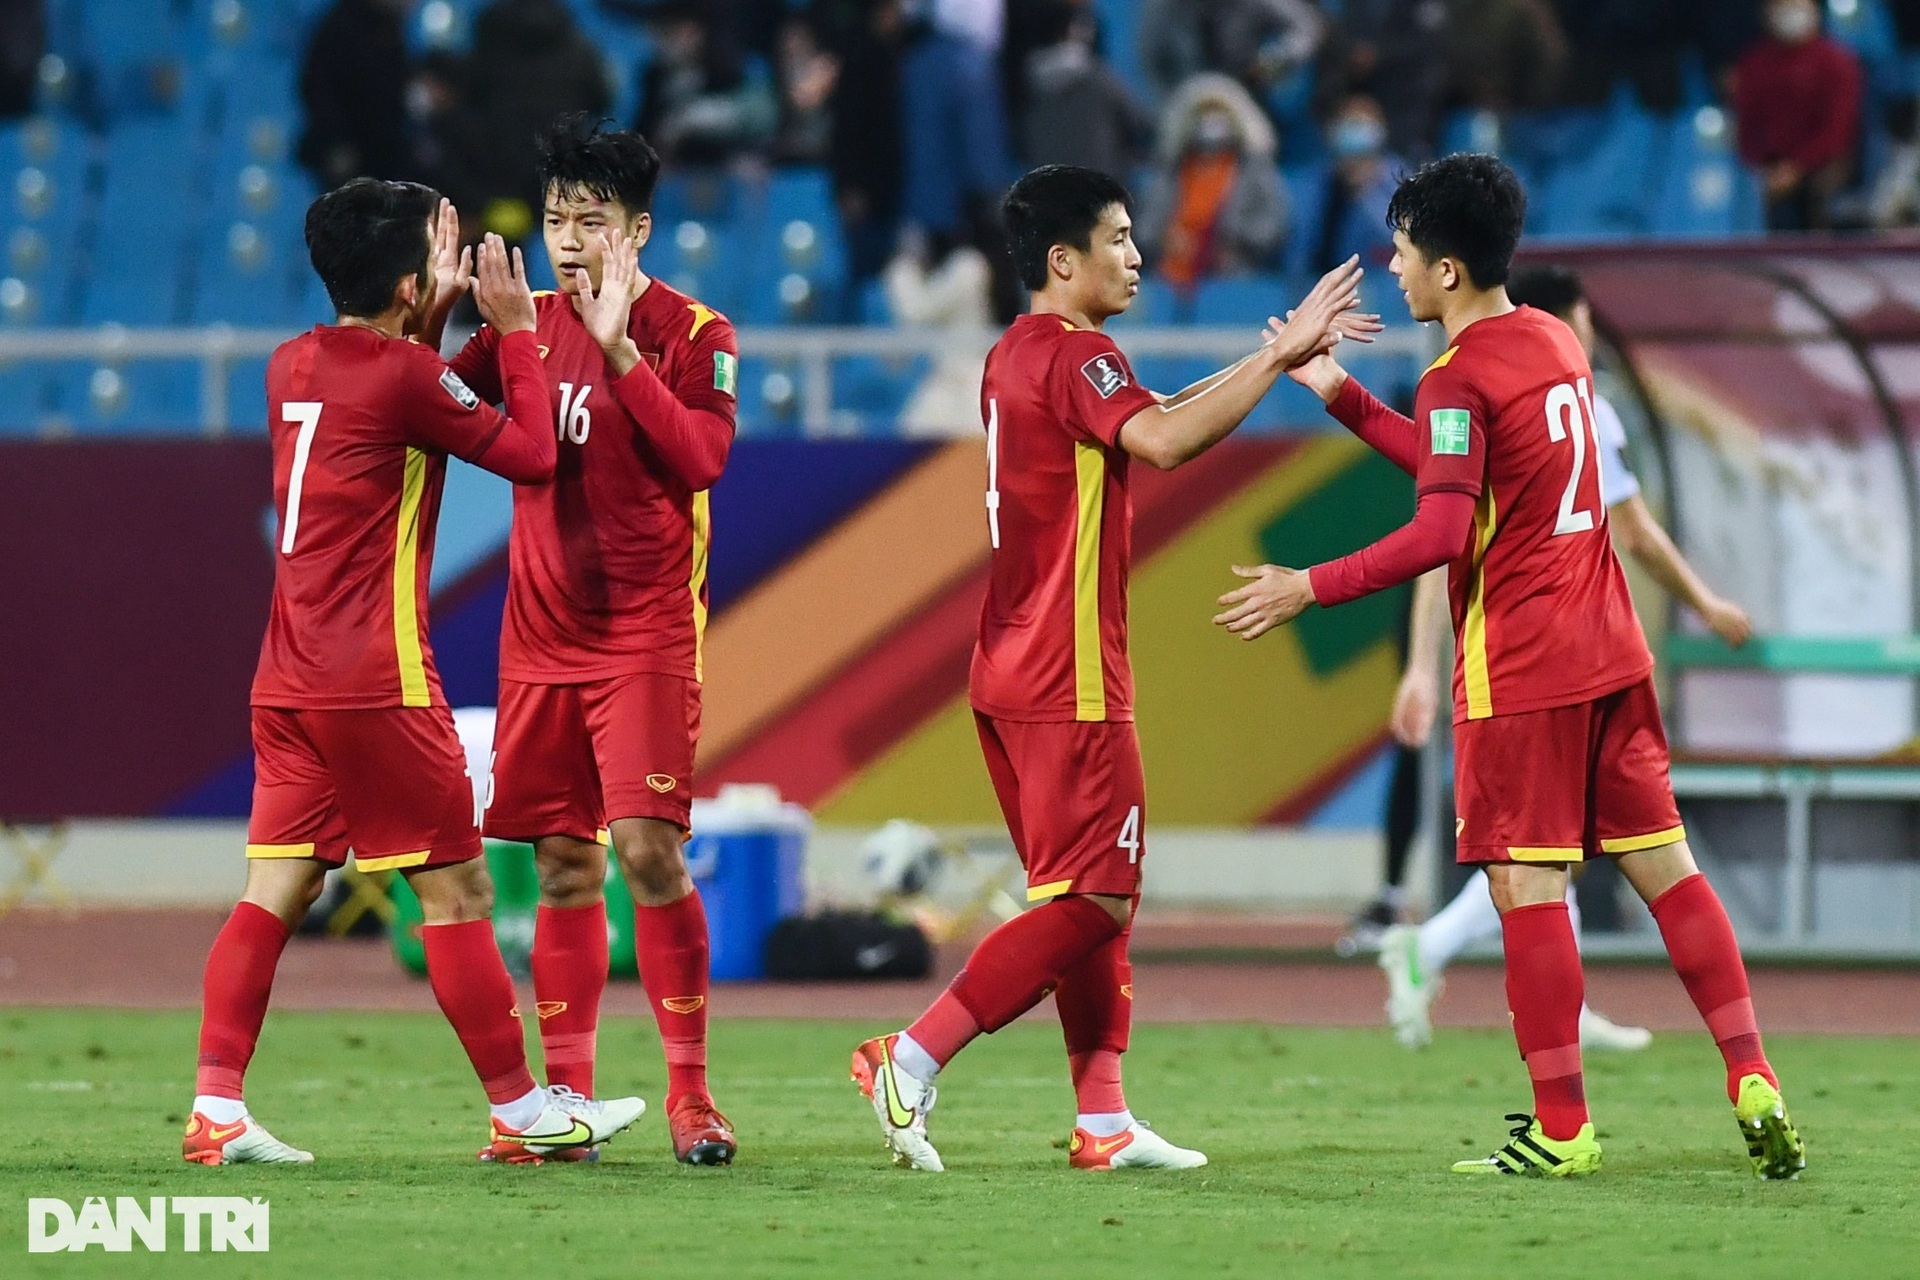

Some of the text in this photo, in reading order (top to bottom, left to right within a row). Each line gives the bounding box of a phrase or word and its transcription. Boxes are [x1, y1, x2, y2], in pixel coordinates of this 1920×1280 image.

[558, 381, 592, 445] 16
[1544, 376, 1606, 536] 21
[281, 401, 324, 554] 7
[1117, 805, 1140, 864] 4
